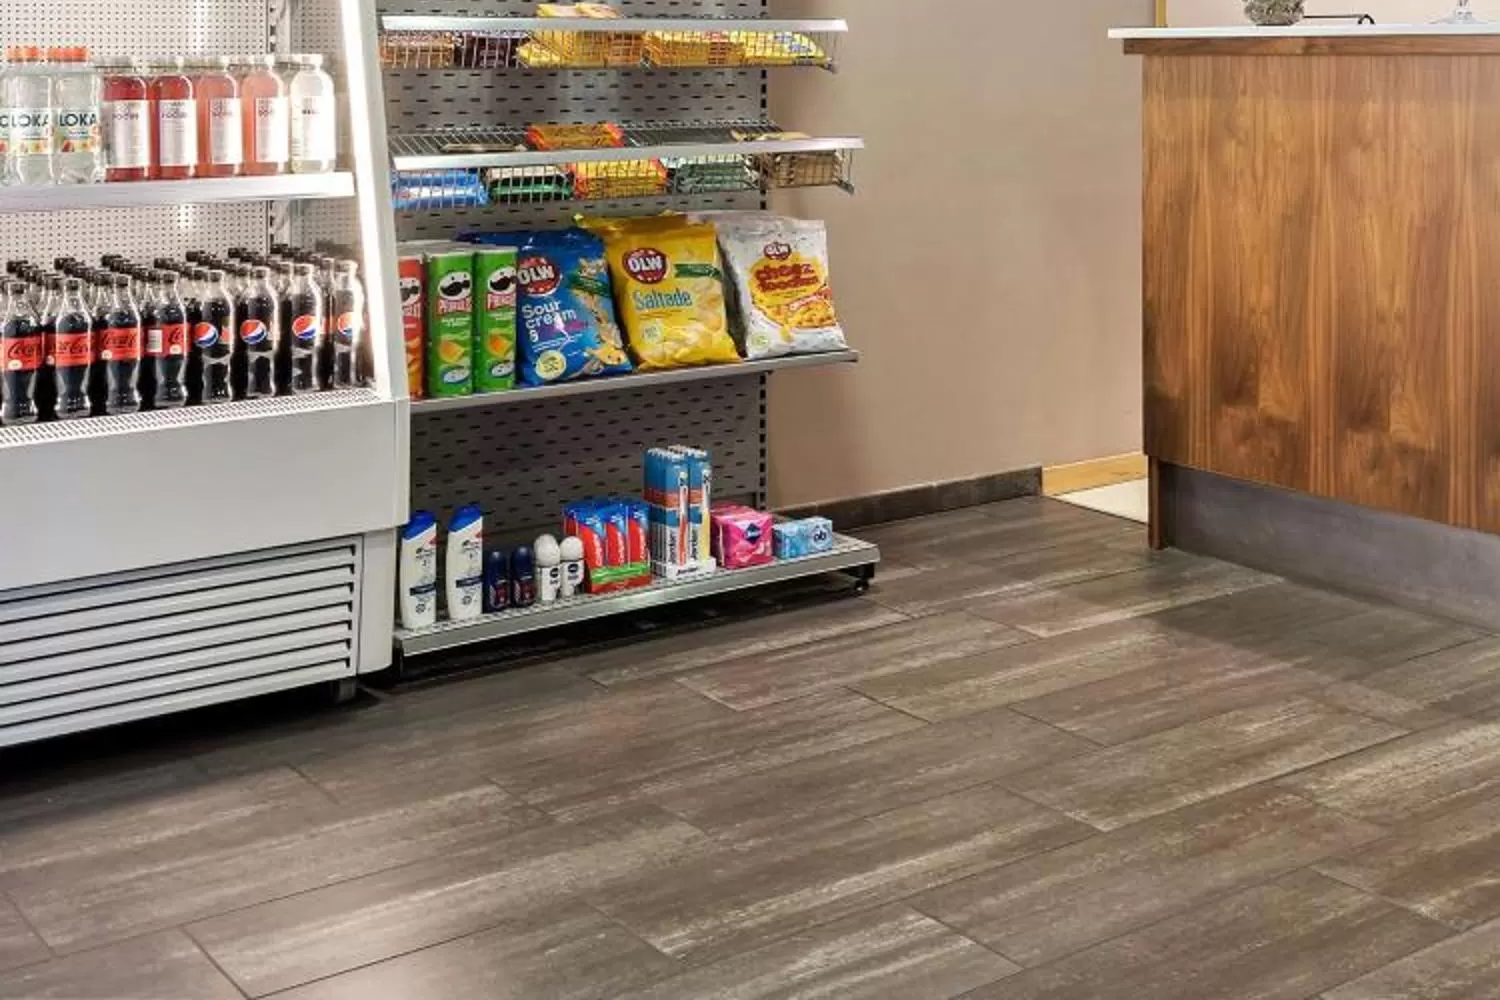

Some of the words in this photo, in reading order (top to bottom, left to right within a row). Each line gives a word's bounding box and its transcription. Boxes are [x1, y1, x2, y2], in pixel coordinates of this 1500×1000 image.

[59, 112, 96, 127] LOKA
[627, 255, 664, 273] OLW
[518, 265, 556, 285] OLW
[521, 299, 562, 320] Sour
[632, 288, 693, 312] Saltade
